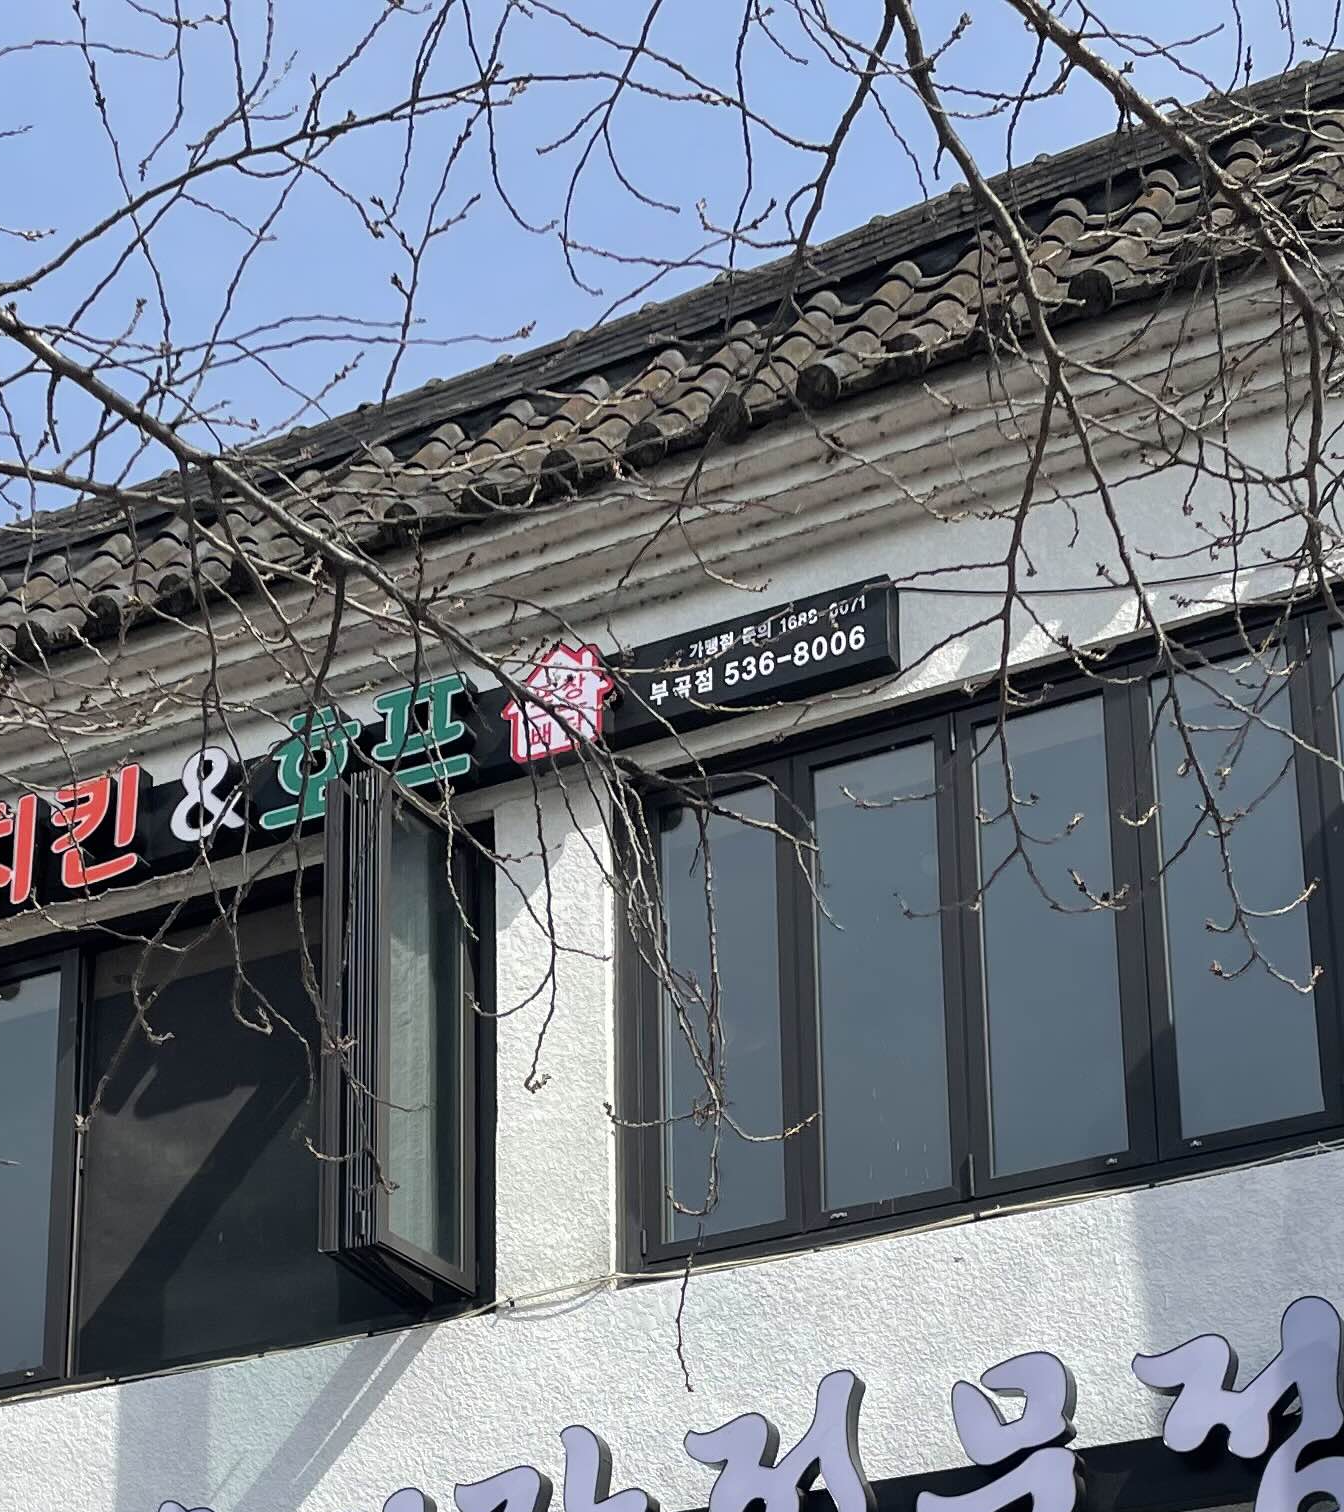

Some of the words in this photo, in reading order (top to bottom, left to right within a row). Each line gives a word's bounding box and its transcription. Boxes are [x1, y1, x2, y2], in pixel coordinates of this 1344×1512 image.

[649, 667, 714, 707] 부곡점
[724, 625, 866, 686] 536-8006
[689, 631, 734, 658] 가맹점
[170, 746, 246, 843] &
[258, 672, 471, 831] 호프
